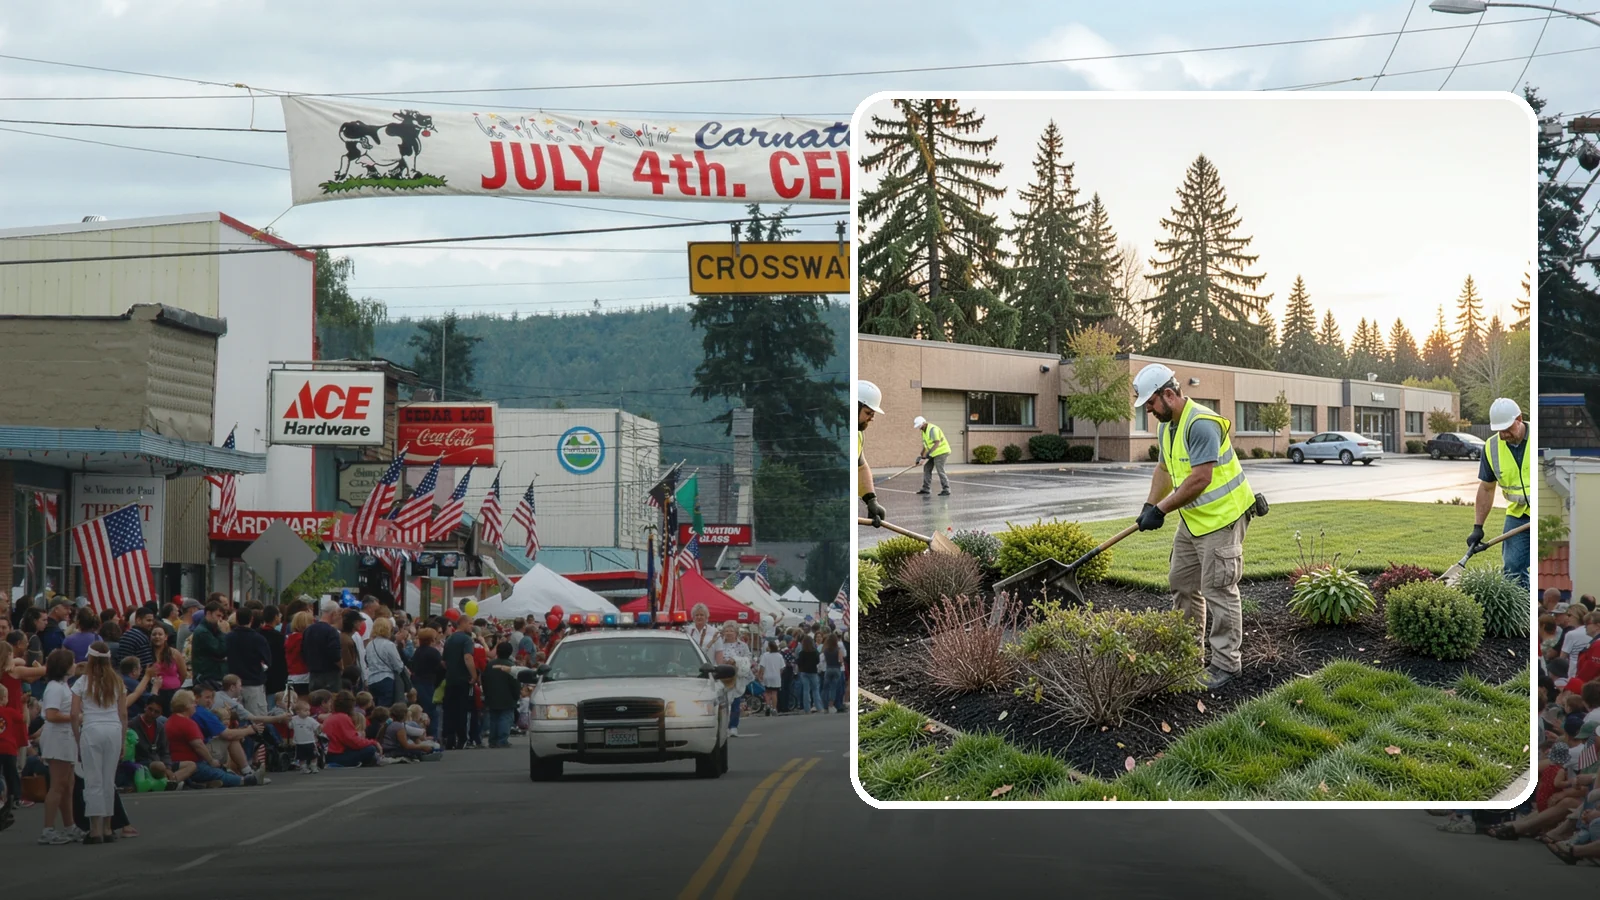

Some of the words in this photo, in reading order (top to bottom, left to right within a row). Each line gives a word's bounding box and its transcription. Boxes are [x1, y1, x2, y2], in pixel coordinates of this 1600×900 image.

[694, 121, 850, 149] Carnat
[481, 141, 605, 192] JULY
[632, 150, 746, 198] 4th.
[697, 254, 850, 280] CROSSWA
[282, 380, 374, 420] ACE
[406, 410, 452, 422] CEDAR
[461, 410, 485, 422] LOG
[283, 421, 371, 436] Hardware
[416, 428, 477, 447] Coca-Cola
[353, 467, 386, 481] Simpl
[83, 486, 93, 495] St.
[96, 485, 124, 495] Vincent
[126, 486, 136, 495] de
[138, 486, 155, 495] Paul
[213, 516, 331, 535] HARDARE
[688, 526, 741, 535] CRNATION
[699, 535, 730, 543] GLASS
